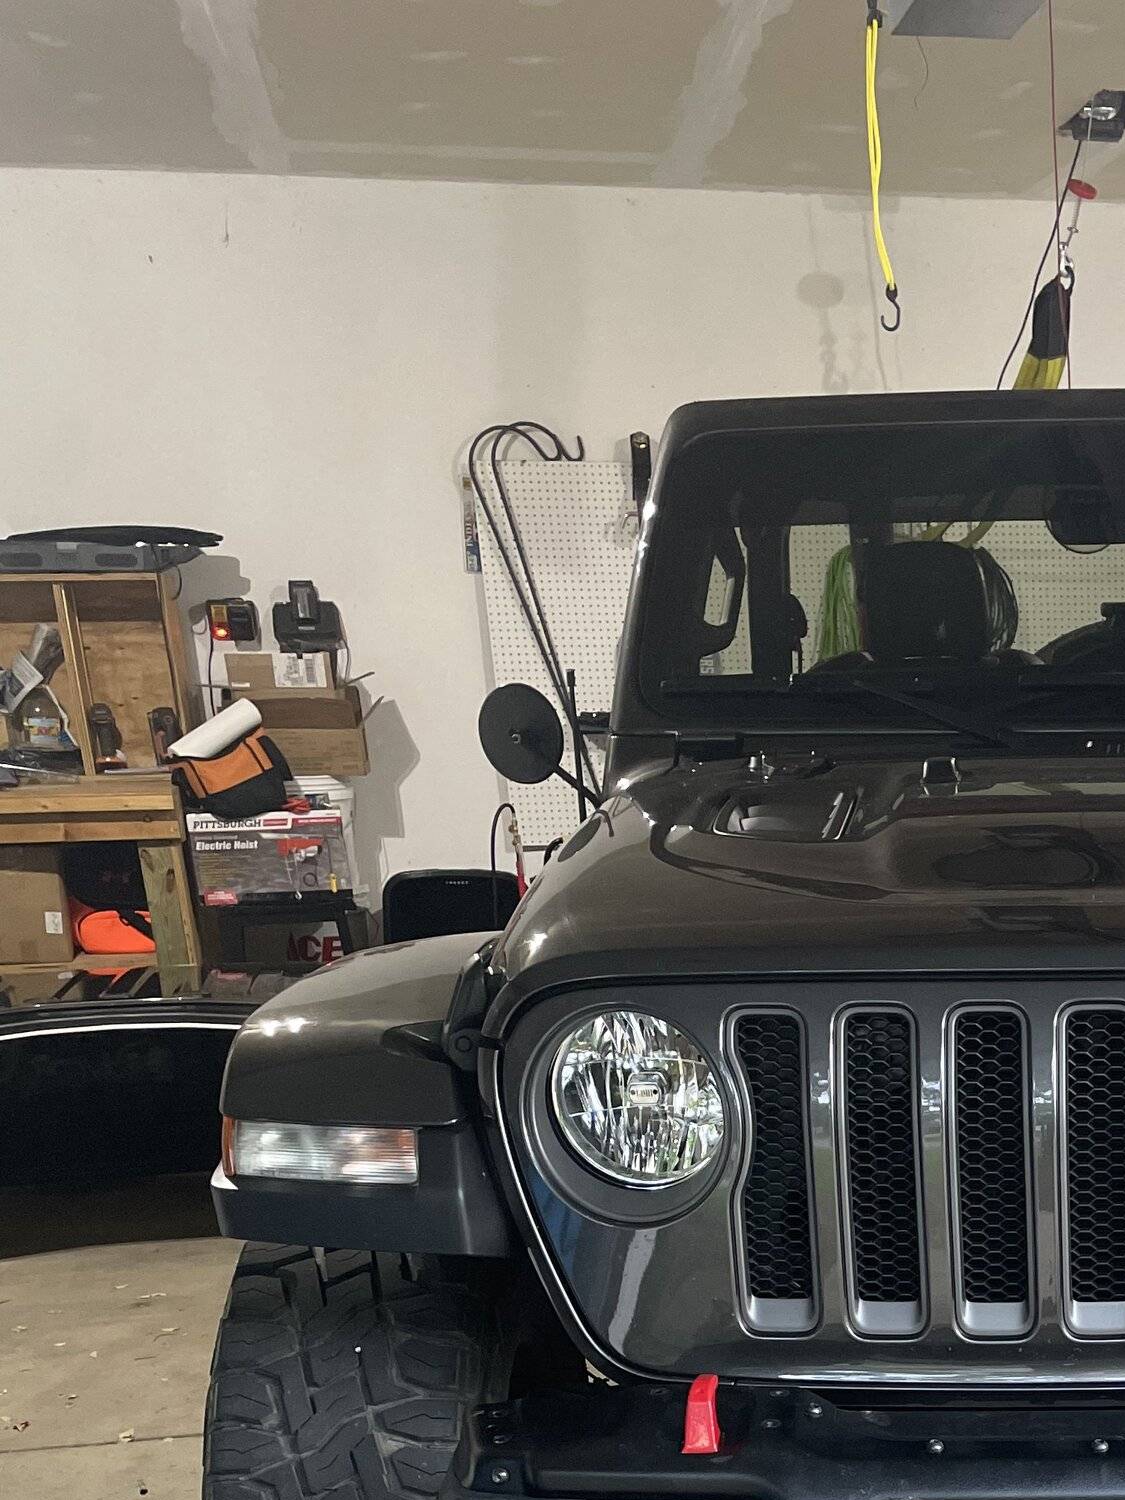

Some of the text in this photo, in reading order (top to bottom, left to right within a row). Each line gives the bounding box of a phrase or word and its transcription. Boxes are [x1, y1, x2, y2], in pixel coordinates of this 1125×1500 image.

[193, 819, 261, 829] PITTSBURGH
[196, 840, 259, 851] Electric Hoist
